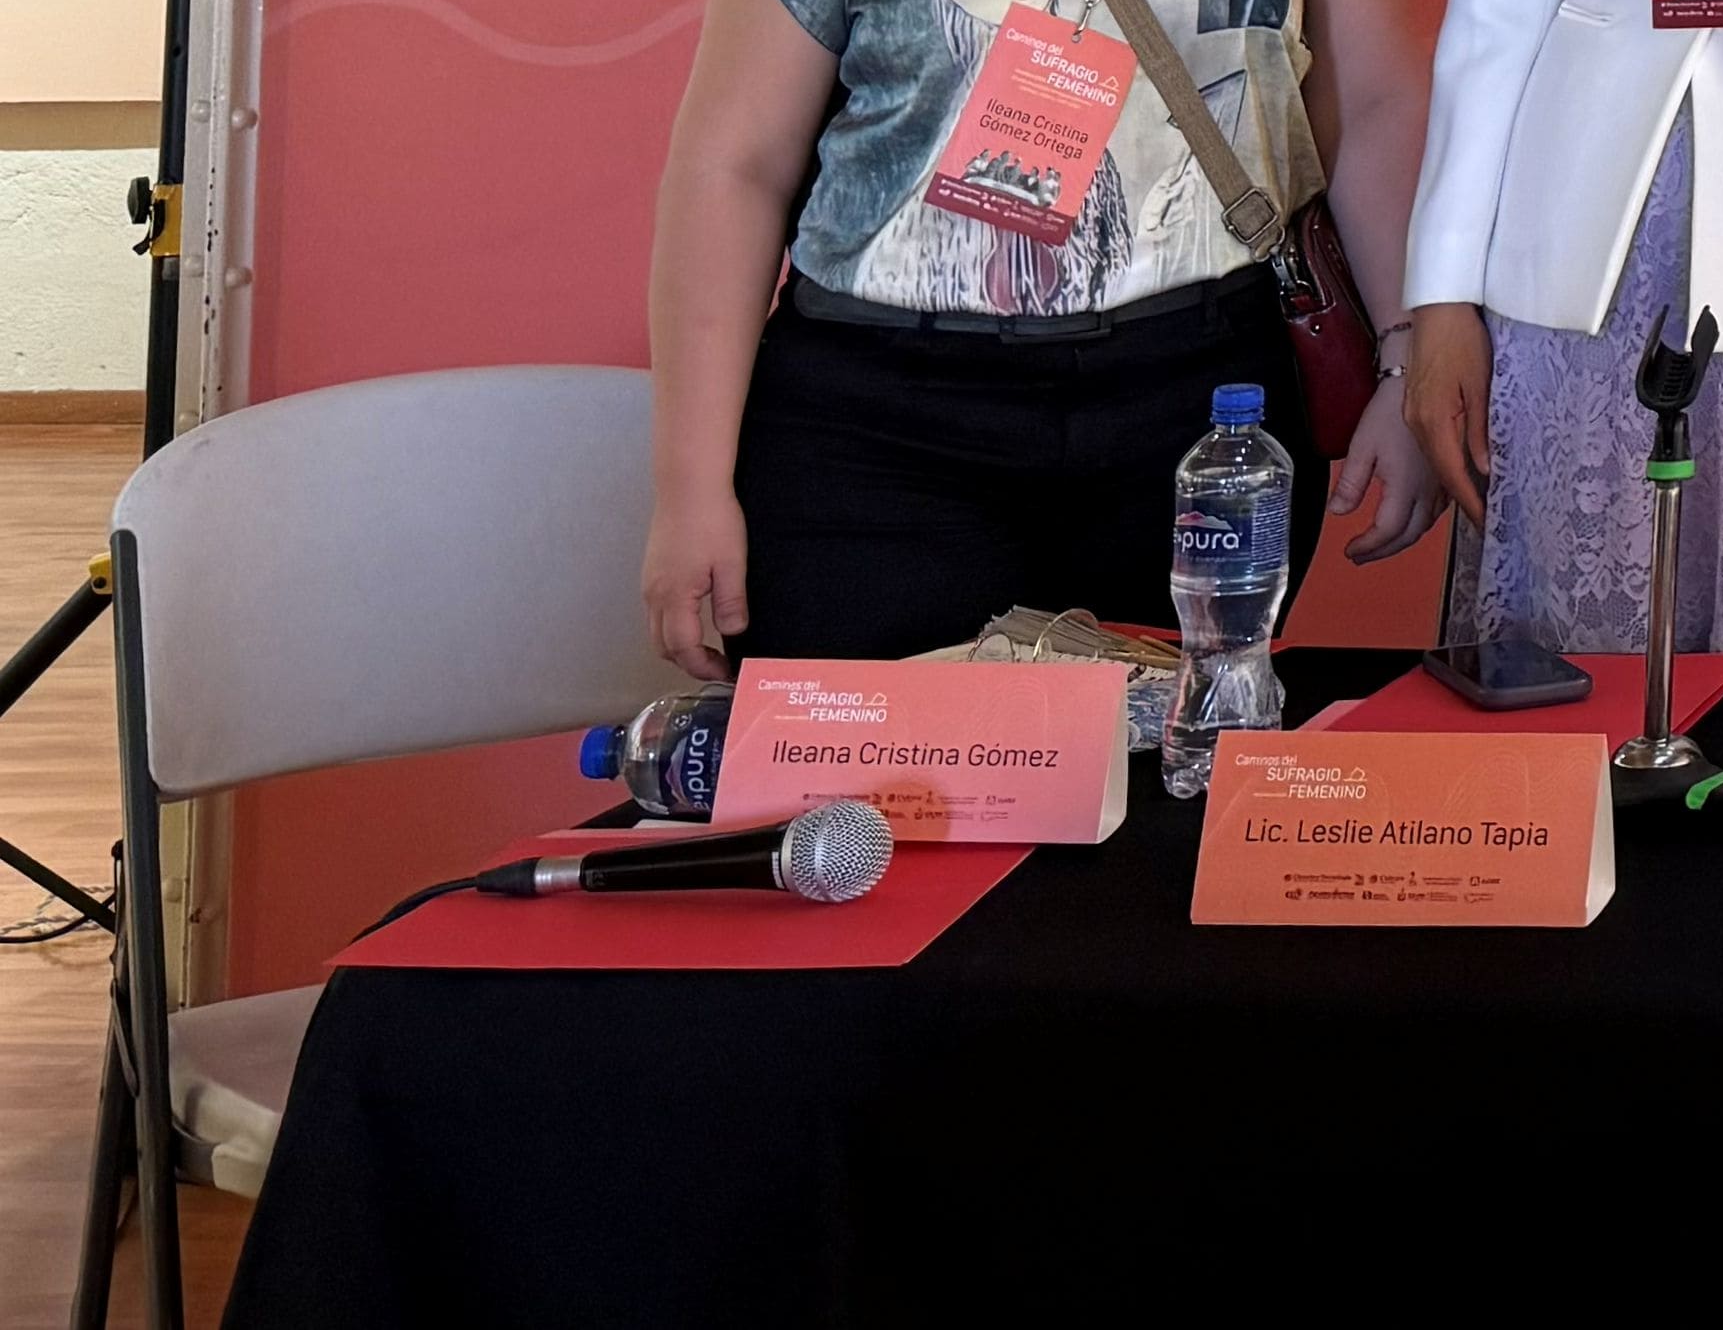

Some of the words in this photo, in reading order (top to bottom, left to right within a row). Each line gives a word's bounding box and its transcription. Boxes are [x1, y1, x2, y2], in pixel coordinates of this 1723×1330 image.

[1031, 51, 1099, 83] SUFRAGIO
[1047, 72, 1117, 106] FEMENINO
[987, 98, 1031, 124] Ileana
[1033, 114, 1089, 144] Cristina
[980, 114, 1031, 142] Gómez
[1033, 130, 1083, 159] Ortega
[787, 692, 864, 706] SUFRAGIO
[803, 680, 820, 691] del
[809, 708, 887, 723] FEMENINO
[772, 740, 851, 764] Ileana
[859, 741, 960, 766] Cristina
[968, 743, 1059, 768] Gómez
[1266, 768, 1342, 782] SUFRAGIO
[1288, 785, 1367, 799] FEMENINO
[1245, 819, 1288, 843] Lic.
[1297, 820, 1374, 844] Leslie
[1379, 821, 1473, 845] Atilano
[1481, 822, 1549, 851] Tapia
